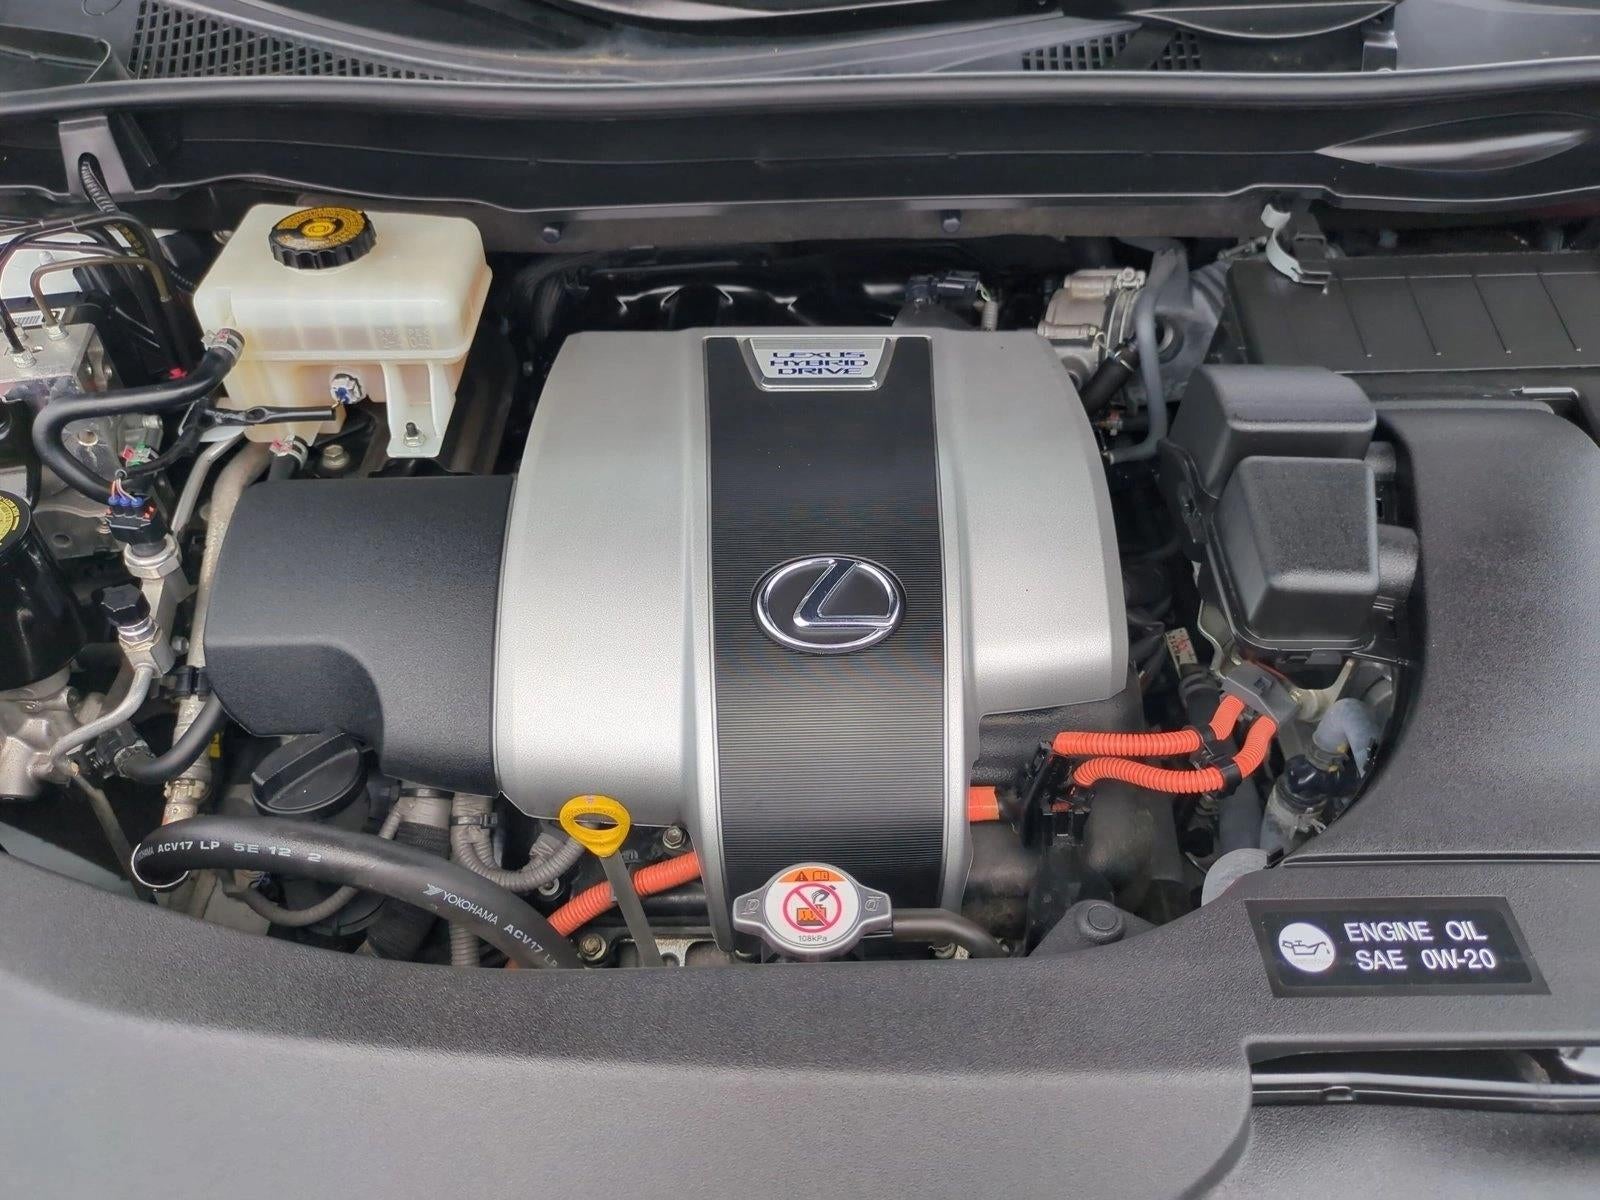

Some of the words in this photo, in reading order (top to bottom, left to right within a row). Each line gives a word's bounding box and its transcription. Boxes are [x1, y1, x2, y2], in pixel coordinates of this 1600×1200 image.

[772, 351, 865, 359] LEXUS
[778, 367, 862, 375] DRIVE
[157, 840, 193, 853] ACV17
[200, 841, 220, 850] LP
[233, 843, 259, 853] 5E
[268, 846, 292, 857] 12
[307, 853, 322, 863] 2
[442, 891, 499, 925] YOKOHAMA
[503, 924, 543, 953] ACV17
[1343, 920, 1434, 942] ENGINE
[1445, 920, 1488, 941] OIL
[1355, 949, 1408, 971] SAE
[1420, 948, 1497, 970] 0W-20
